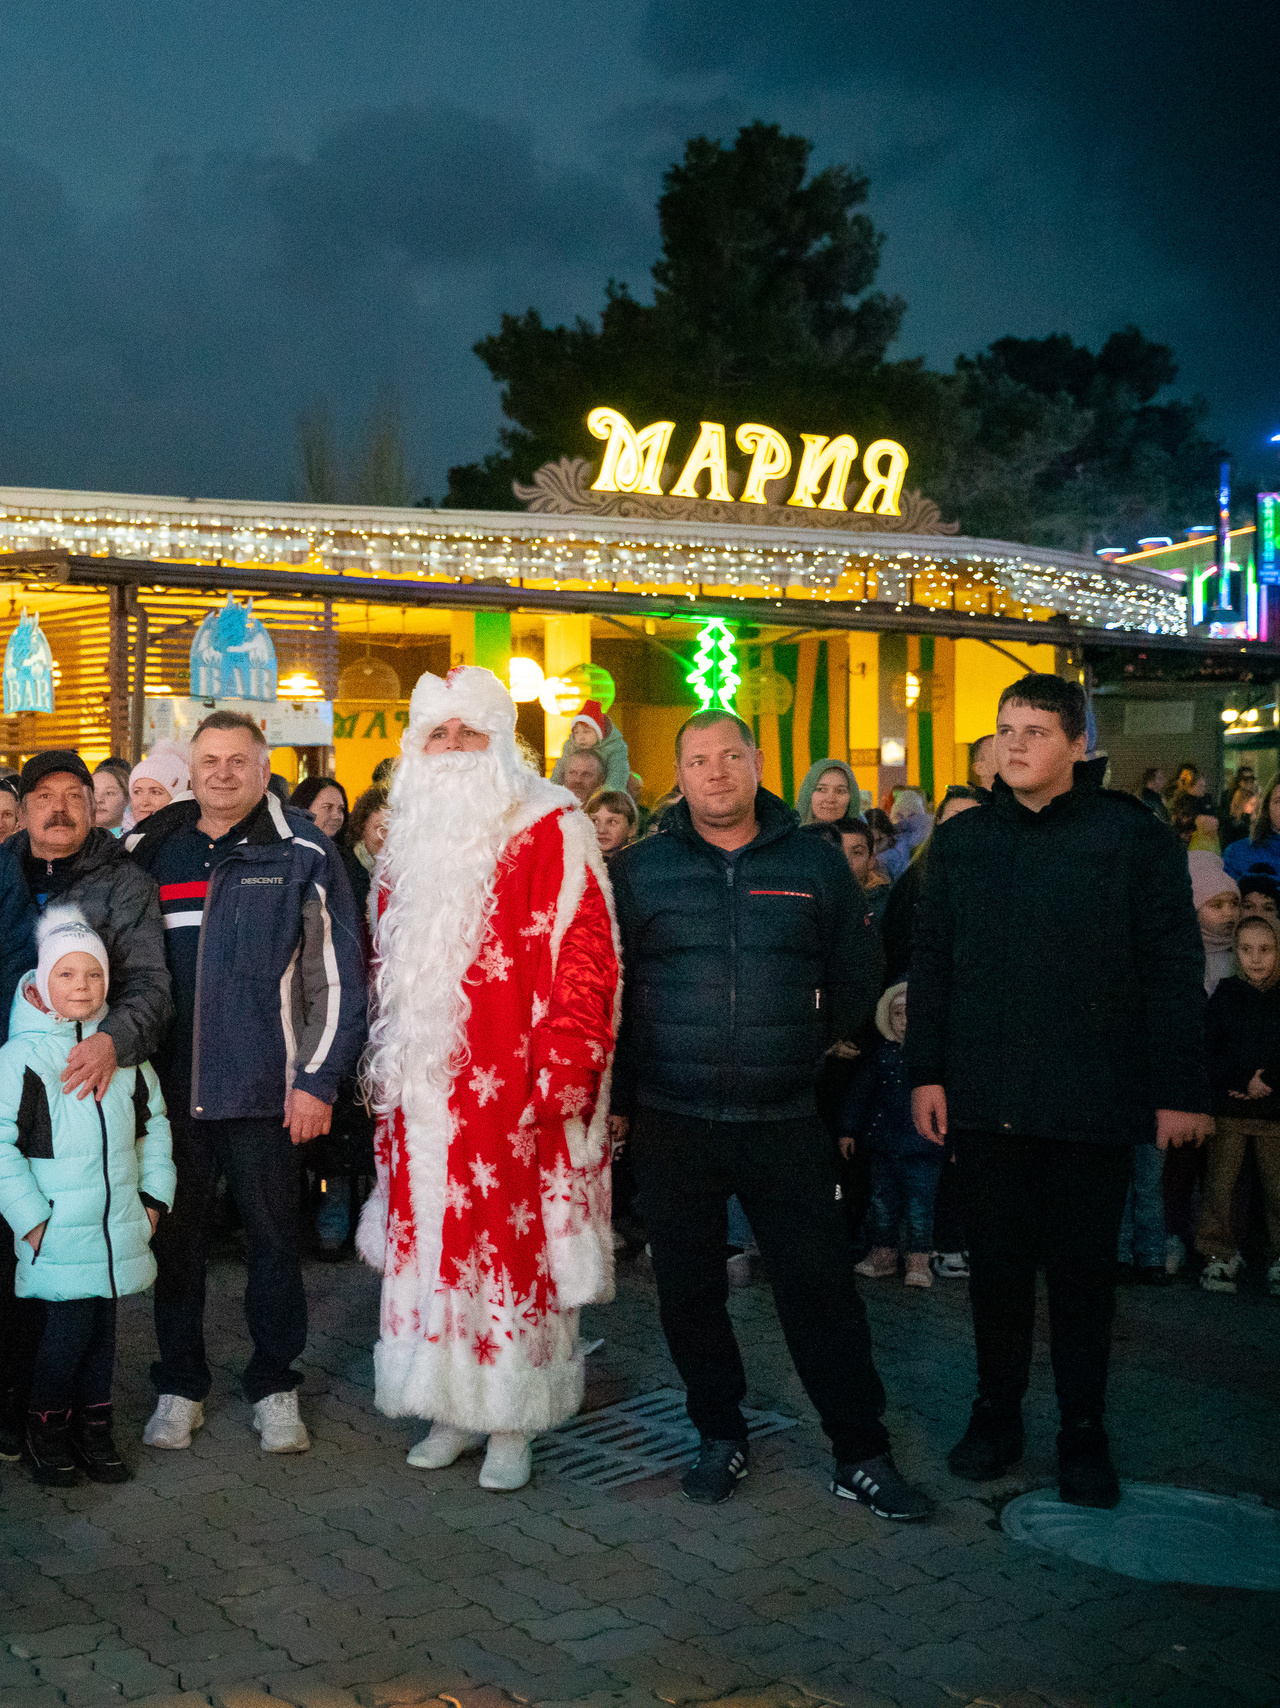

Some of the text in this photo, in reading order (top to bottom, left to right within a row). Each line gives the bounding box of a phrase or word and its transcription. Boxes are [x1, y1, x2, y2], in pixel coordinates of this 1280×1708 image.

[586, 406, 910, 517] МАРИЯ
[6, 679, 51, 711] BAR
[198, 667, 273, 699] BAR
[240, 876, 284, 885] DESCENTE
